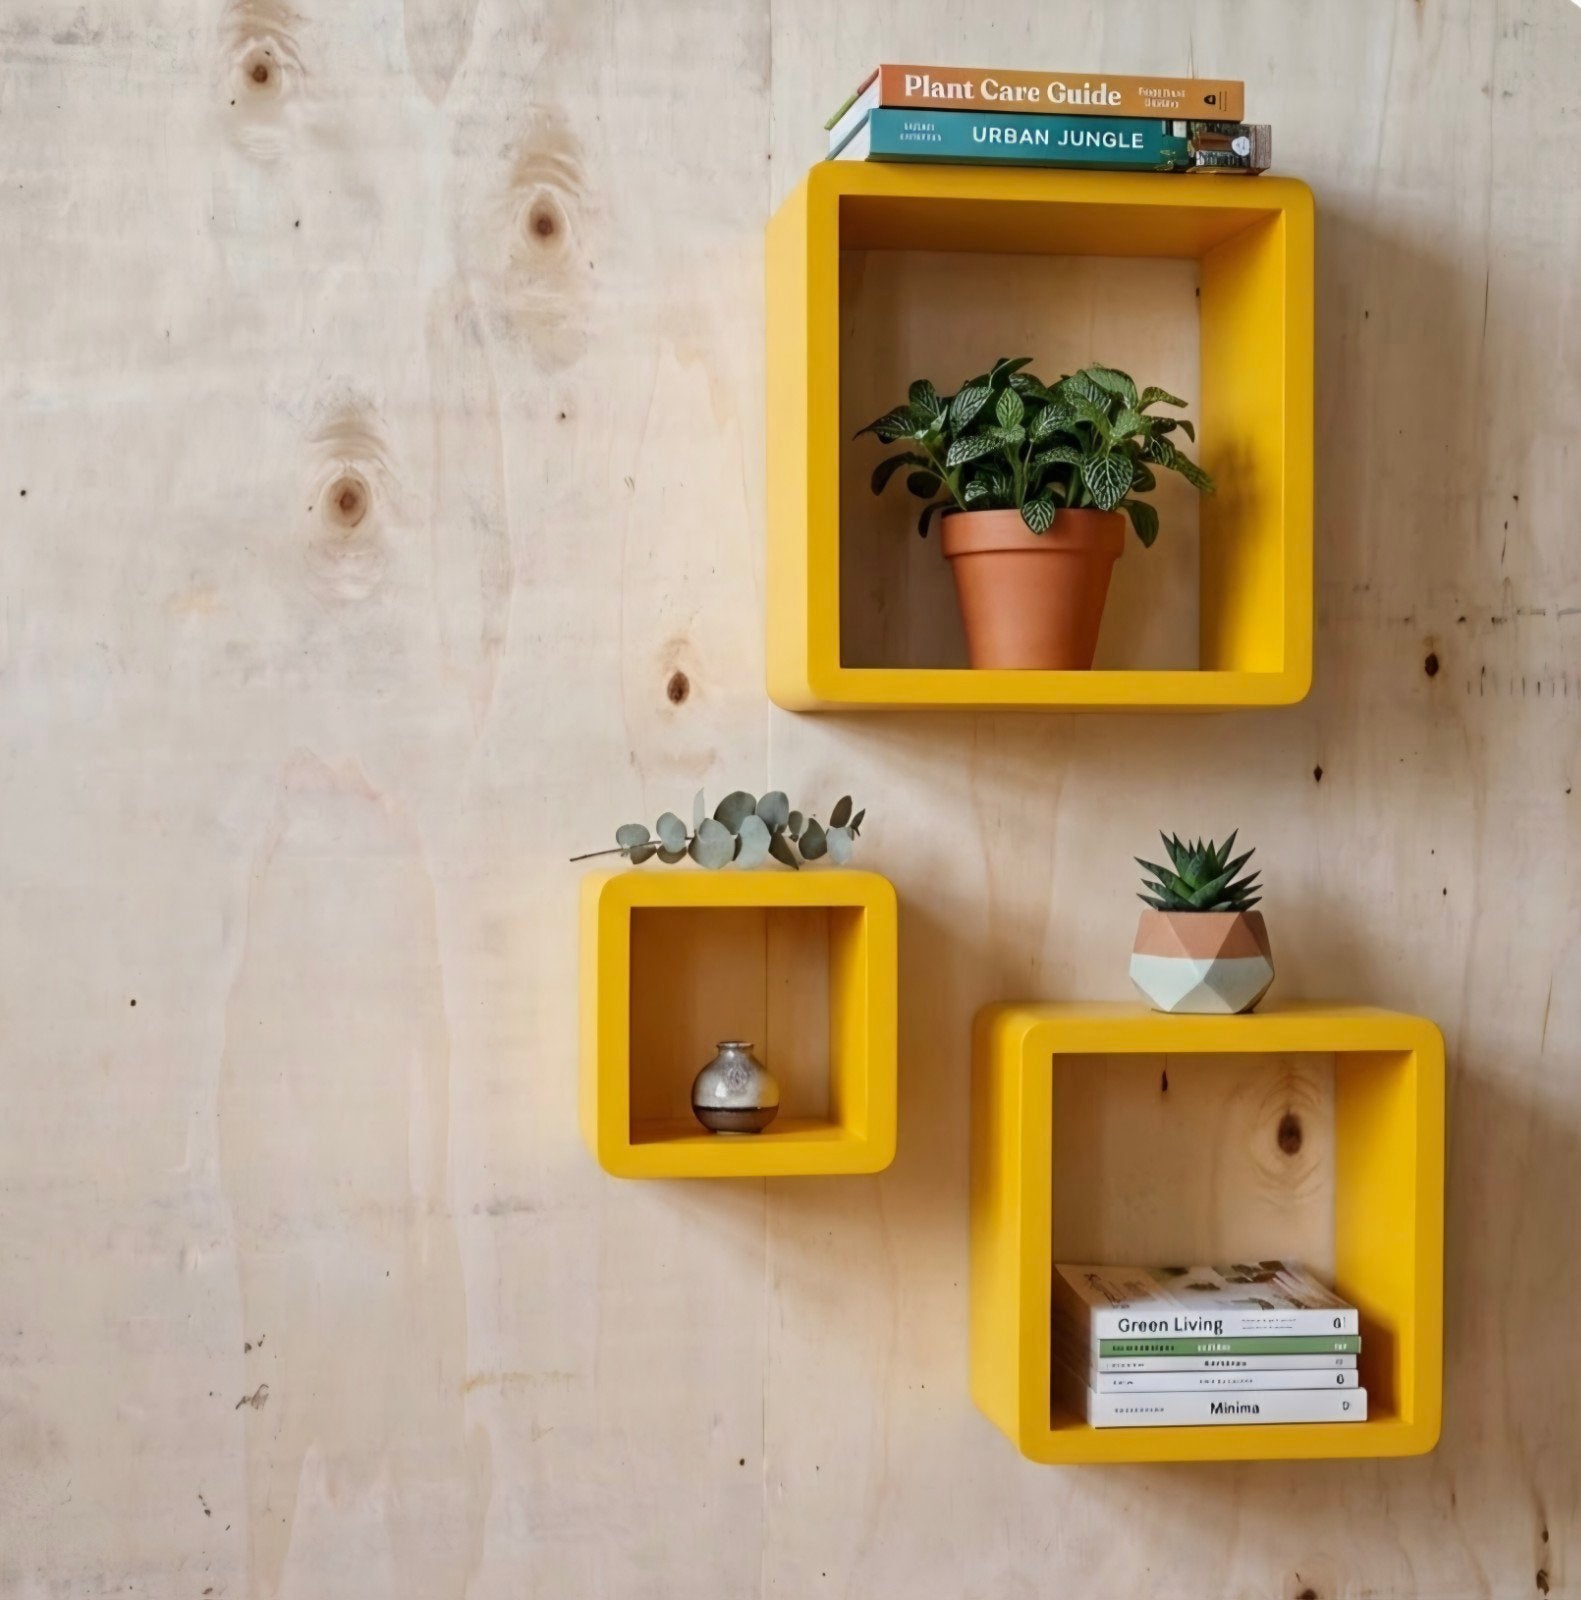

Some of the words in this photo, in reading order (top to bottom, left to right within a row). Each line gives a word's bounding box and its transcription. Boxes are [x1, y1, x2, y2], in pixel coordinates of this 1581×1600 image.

[904, 74, 974, 99] Plant
[980, 78, 1041, 102] Care
[1047, 81, 1122, 106] Guide
[972, 126, 1049, 145] URBAN
[1058, 129, 1145, 149] JUNGLE
[1174, 1316, 1223, 1335] Living
